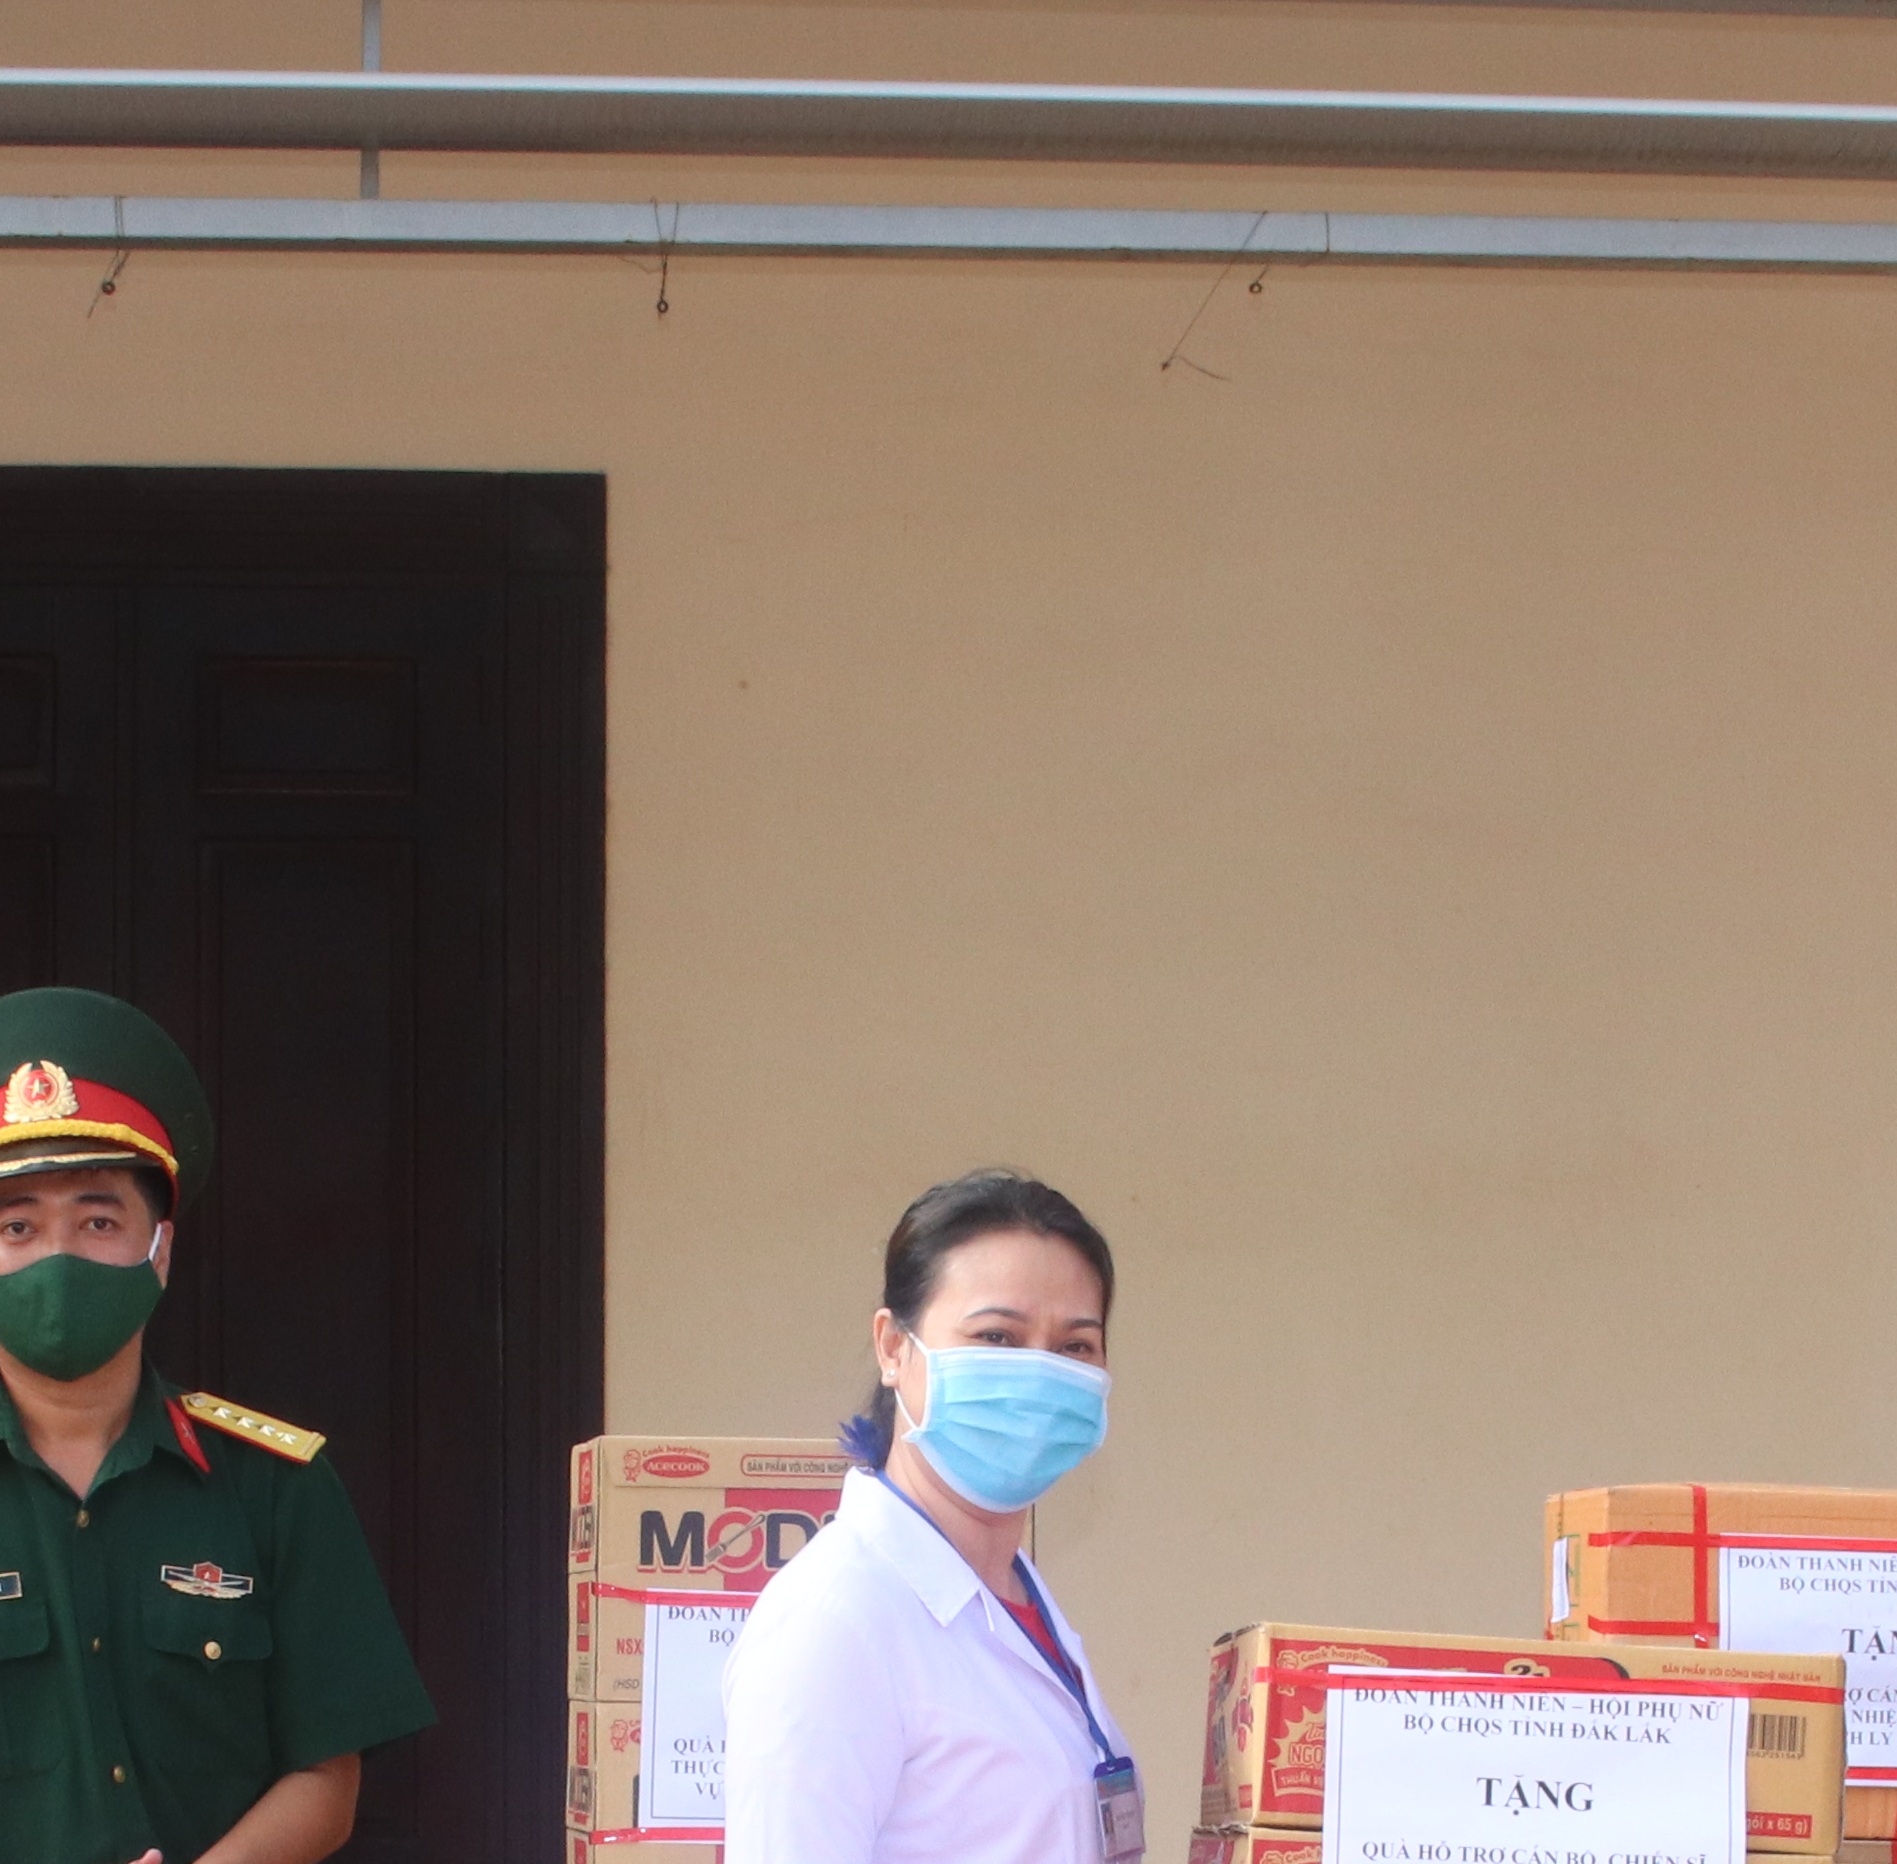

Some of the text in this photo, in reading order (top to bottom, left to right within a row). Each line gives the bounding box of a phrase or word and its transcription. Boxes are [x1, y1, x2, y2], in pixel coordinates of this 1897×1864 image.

[638, 1510, 836, 1571] MOD
[1739, 1553, 1791, 1570] ĐOÀN
[1796, 1556, 1863, 1572] THANH
[1779, 1576, 1805, 1594] BỘ
[1810, 1578, 1861, 1594] CHQS
[708, 1628, 735, 1647] BỘ
[1427, 1690, 1505, 1711] THANH
[1512, 1691, 1566, 1713] NIÊN
[1589, 1696, 1631, 1718] HỘI
[1638, 1701, 1683, 1723] PHỤ
[1688, 1699, 1723, 1721] NỮ
[1404, 1712, 1434, 1736] BỘ
[1441, 1715, 1503, 1737] CHQS
[1509, 1717, 1564, 1739] TỈNH
[673, 1735, 714, 1754] QUÀ
[1869, 1731, 1893, 1746] LY
[670, 1760, 725, 1778] THỰC
[695, 1781, 725, 1800] VỰ
[1476, 1774, 1594, 1817] TẶNG
[1767, 1819, 1774, 1830] x
[1777, 1817, 1792, 1831] 65
[1361, 1838, 1414, 1862] QUÀ
[1419, 1840, 1452, 1862] HỖ
